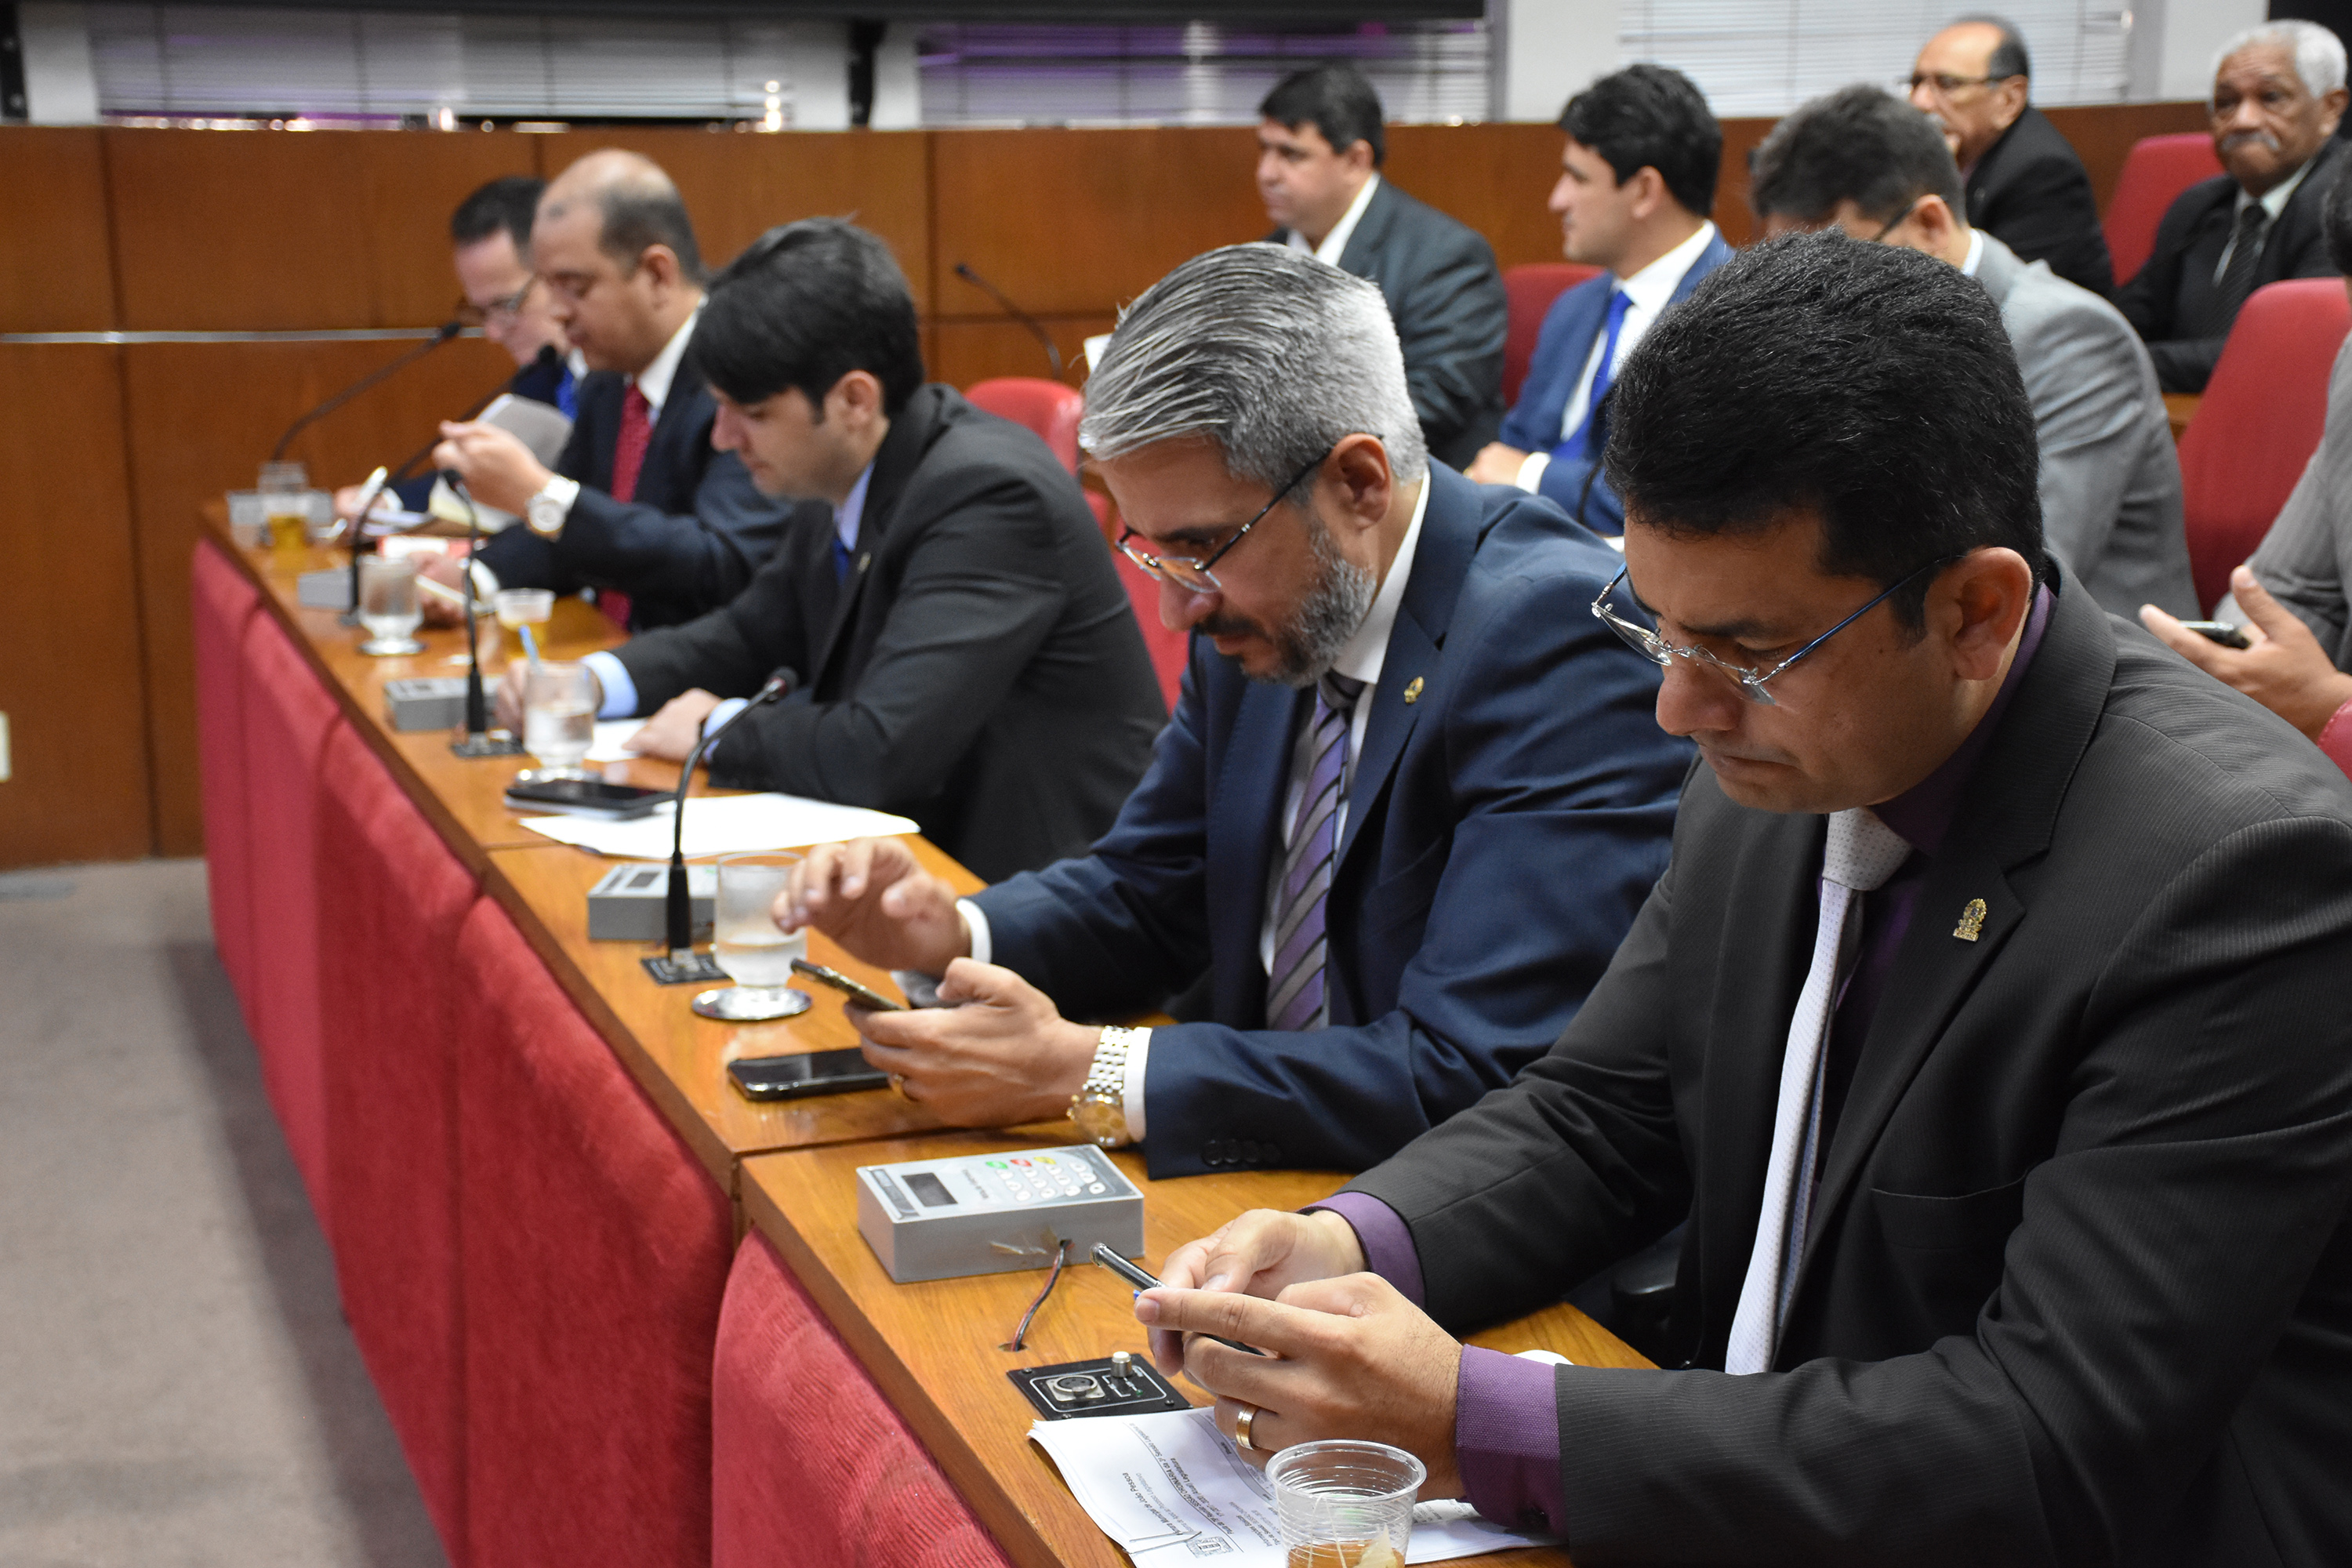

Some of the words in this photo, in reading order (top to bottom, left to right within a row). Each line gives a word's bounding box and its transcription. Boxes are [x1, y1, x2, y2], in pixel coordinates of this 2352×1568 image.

[1149, 1442, 1163, 1457] Sessão
[1171, 1457, 1190, 1483] Legislatura
[1122, 1472, 1138, 1492] Pessoa
[1135, 1472, 1153, 1494] Legislativo
[1166, 1468, 1188, 1494] ORDINÁRIA
[1134, 1492, 1148, 1503] João
[1149, 1508, 1169, 1523] Municipal
